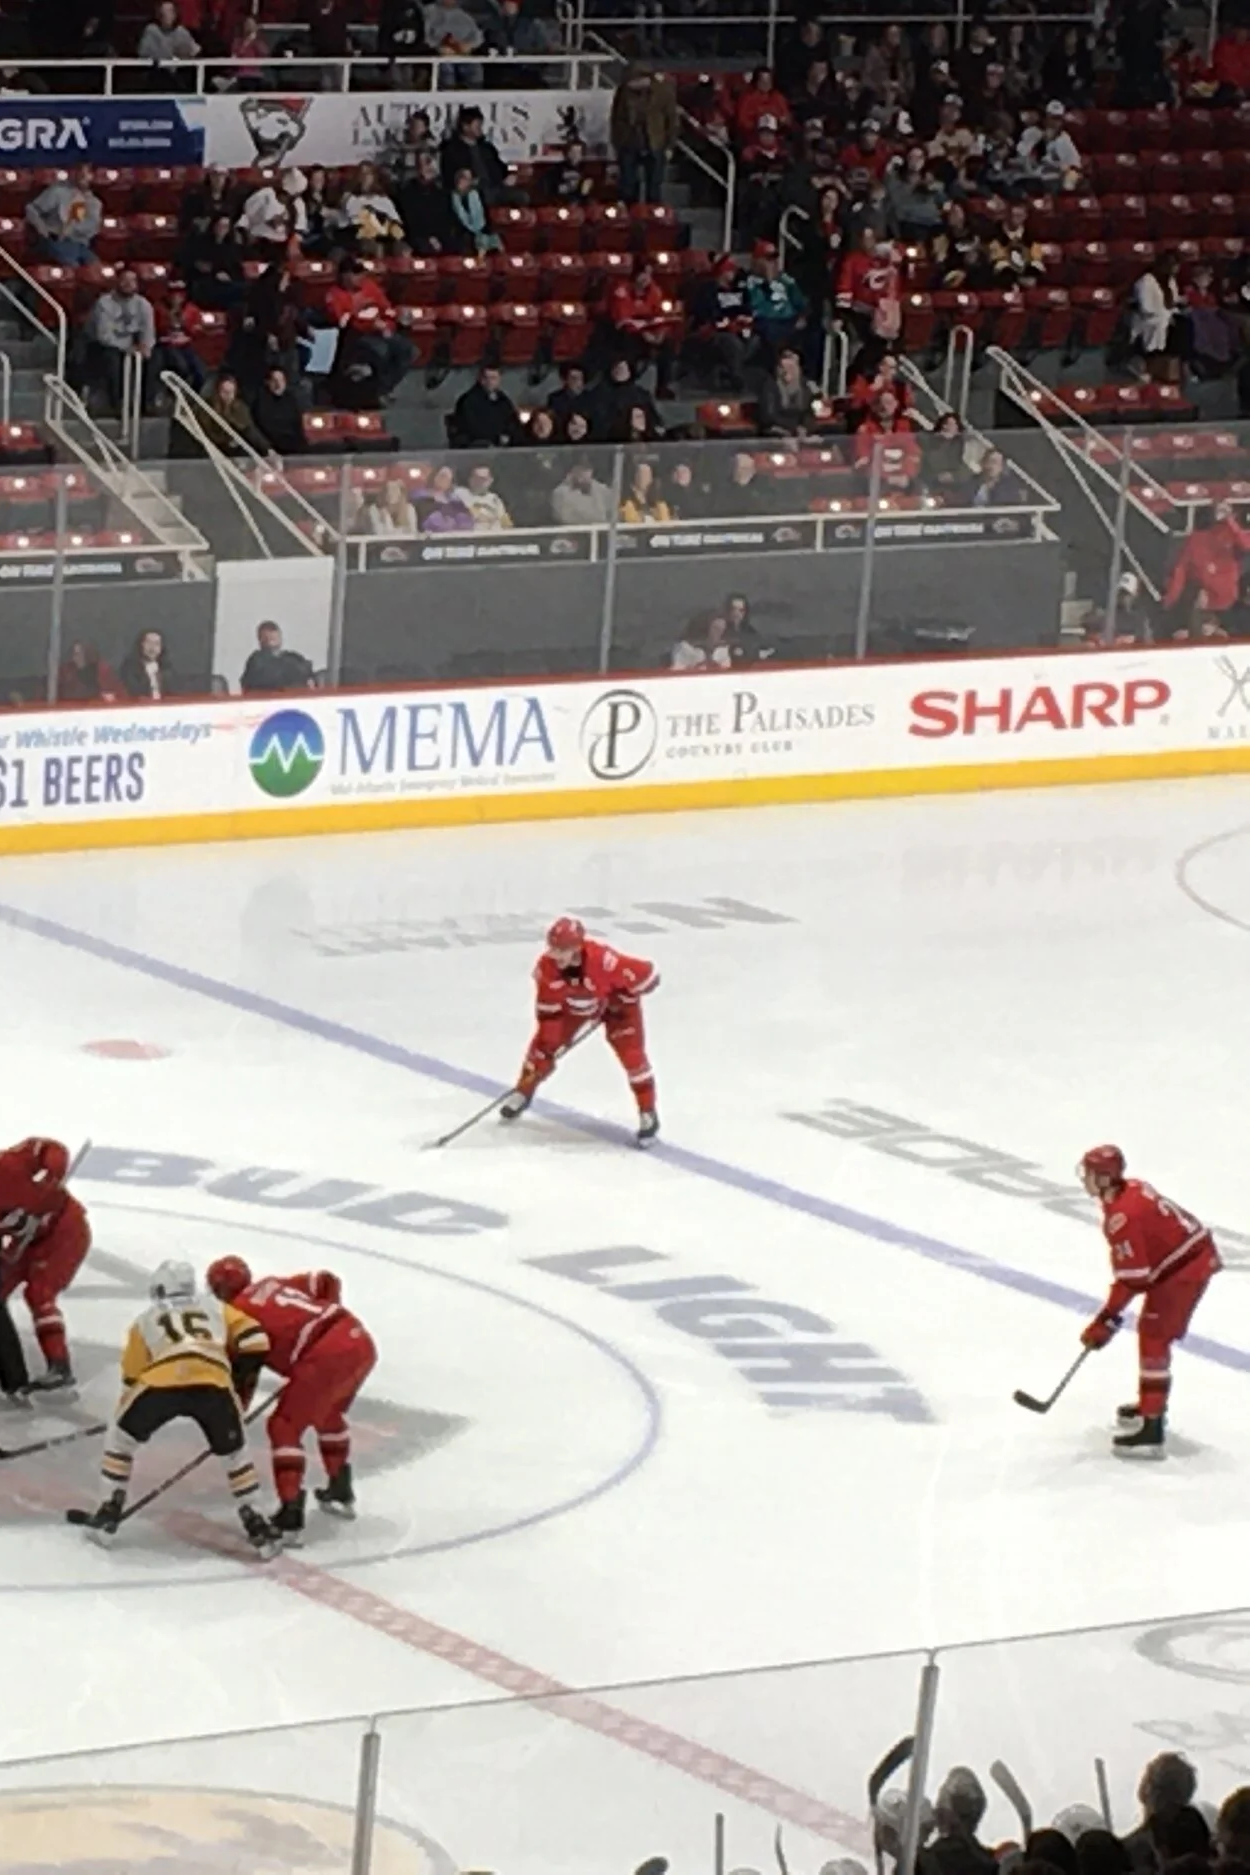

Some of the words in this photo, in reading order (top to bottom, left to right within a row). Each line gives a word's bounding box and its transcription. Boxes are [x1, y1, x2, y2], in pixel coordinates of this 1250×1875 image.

[337, 697, 556, 776] MEMA
[666, 713, 721, 738] THE
[732, 691, 876, 734] PALISADES
[908, 678, 1172, 738] SHARP
[43, 751, 146, 807] BEERS
[76, 1143, 510, 1236] BUD
[522, 1245, 940, 1424] LIGHT
